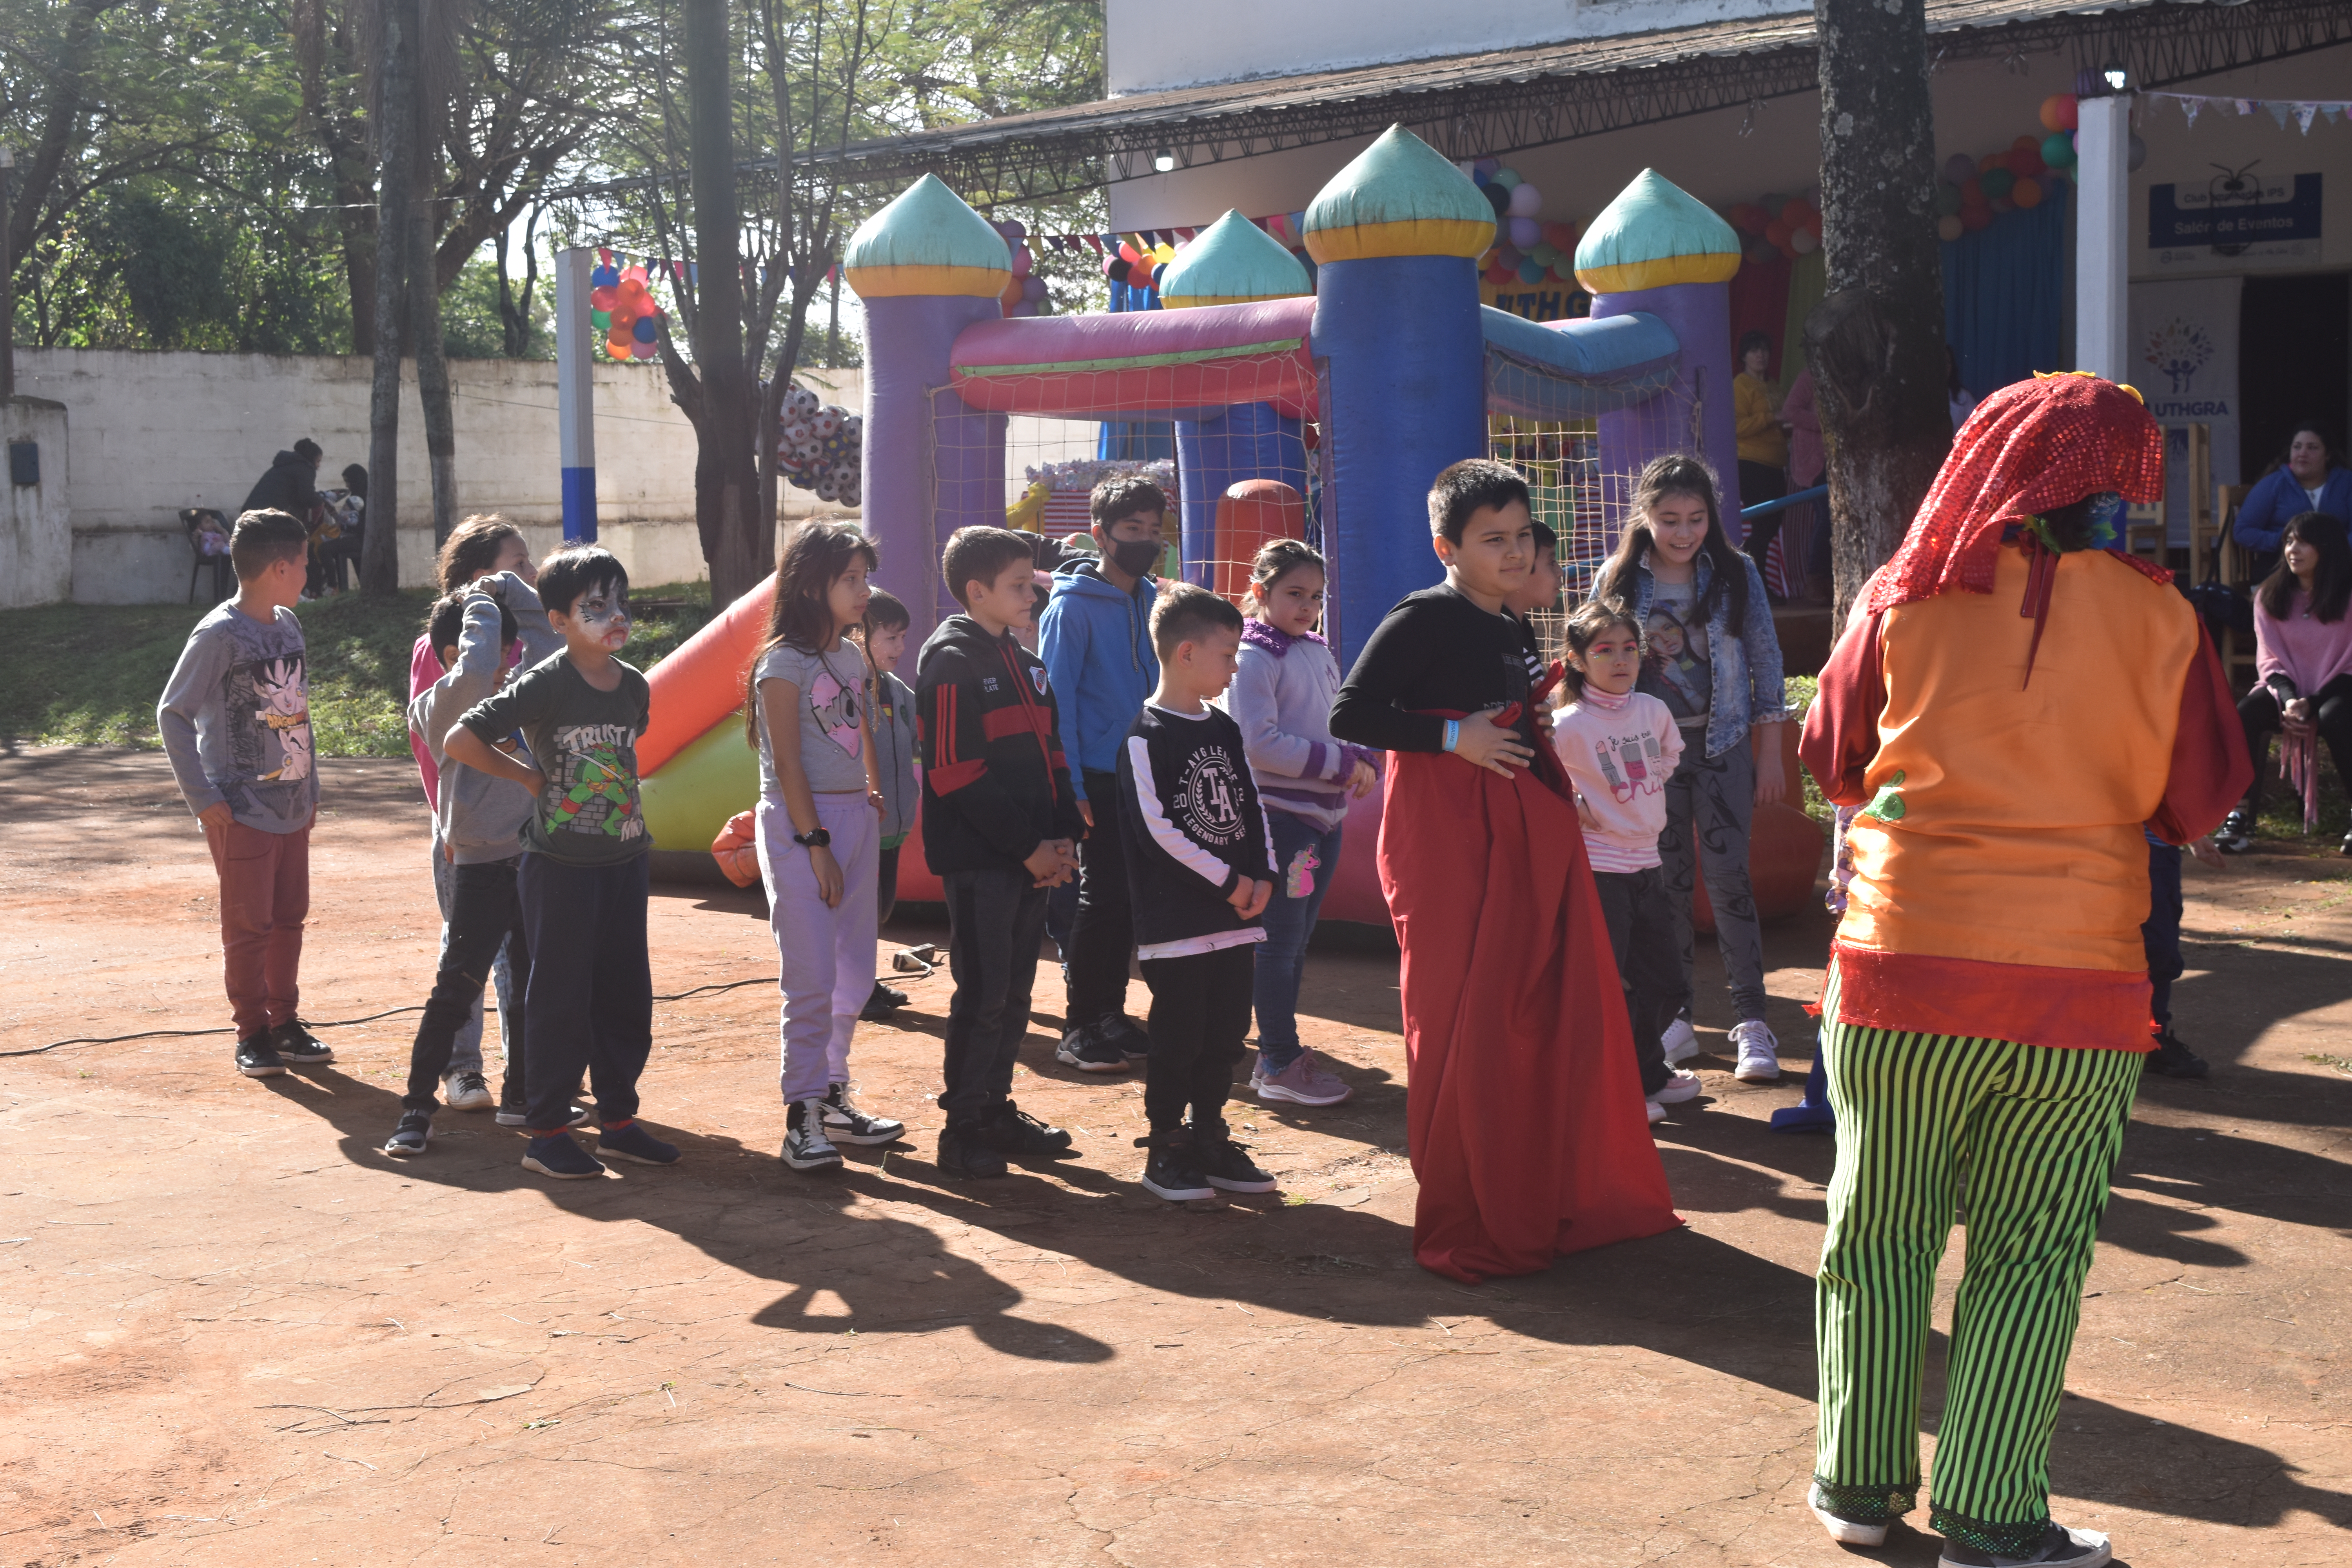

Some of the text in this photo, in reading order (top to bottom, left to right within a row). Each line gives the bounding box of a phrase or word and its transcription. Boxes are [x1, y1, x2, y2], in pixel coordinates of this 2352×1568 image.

[2184, 193, 2206, 203] Club
[2267, 187, 2285, 197] IPS
[2217, 220, 2234, 232] de
[2238, 217, 2294, 230] Eventos
[2155, 401, 2228, 417] UTHGRA
[563, 724, 626, 752] TRUST
[1173, 793, 1188, 809] 20
[1182, 813, 1229, 846] LEGENDARY
